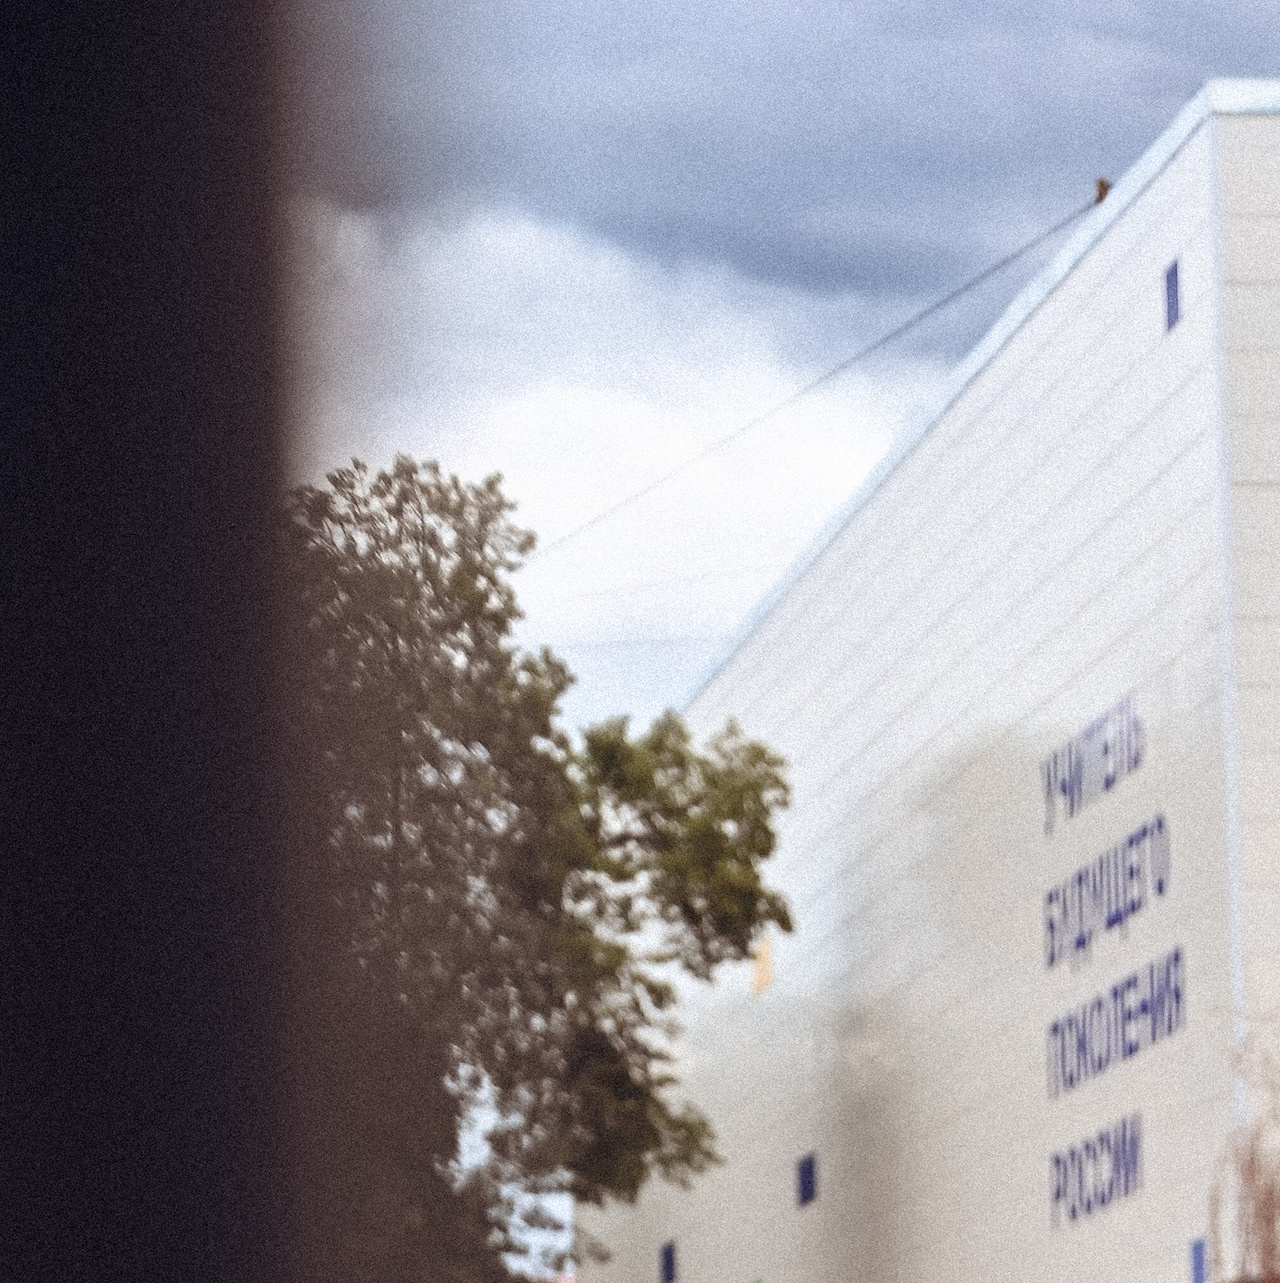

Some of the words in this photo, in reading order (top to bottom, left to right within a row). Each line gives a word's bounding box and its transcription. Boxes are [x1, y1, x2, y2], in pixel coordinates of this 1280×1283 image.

[1043, 811, 1171, 970] БУДУЩЕГО
[1047, 944, 1186, 1099] ПОКОЛЕНИЯ
[1050, 1110, 1143, 1232] РОССИИ
